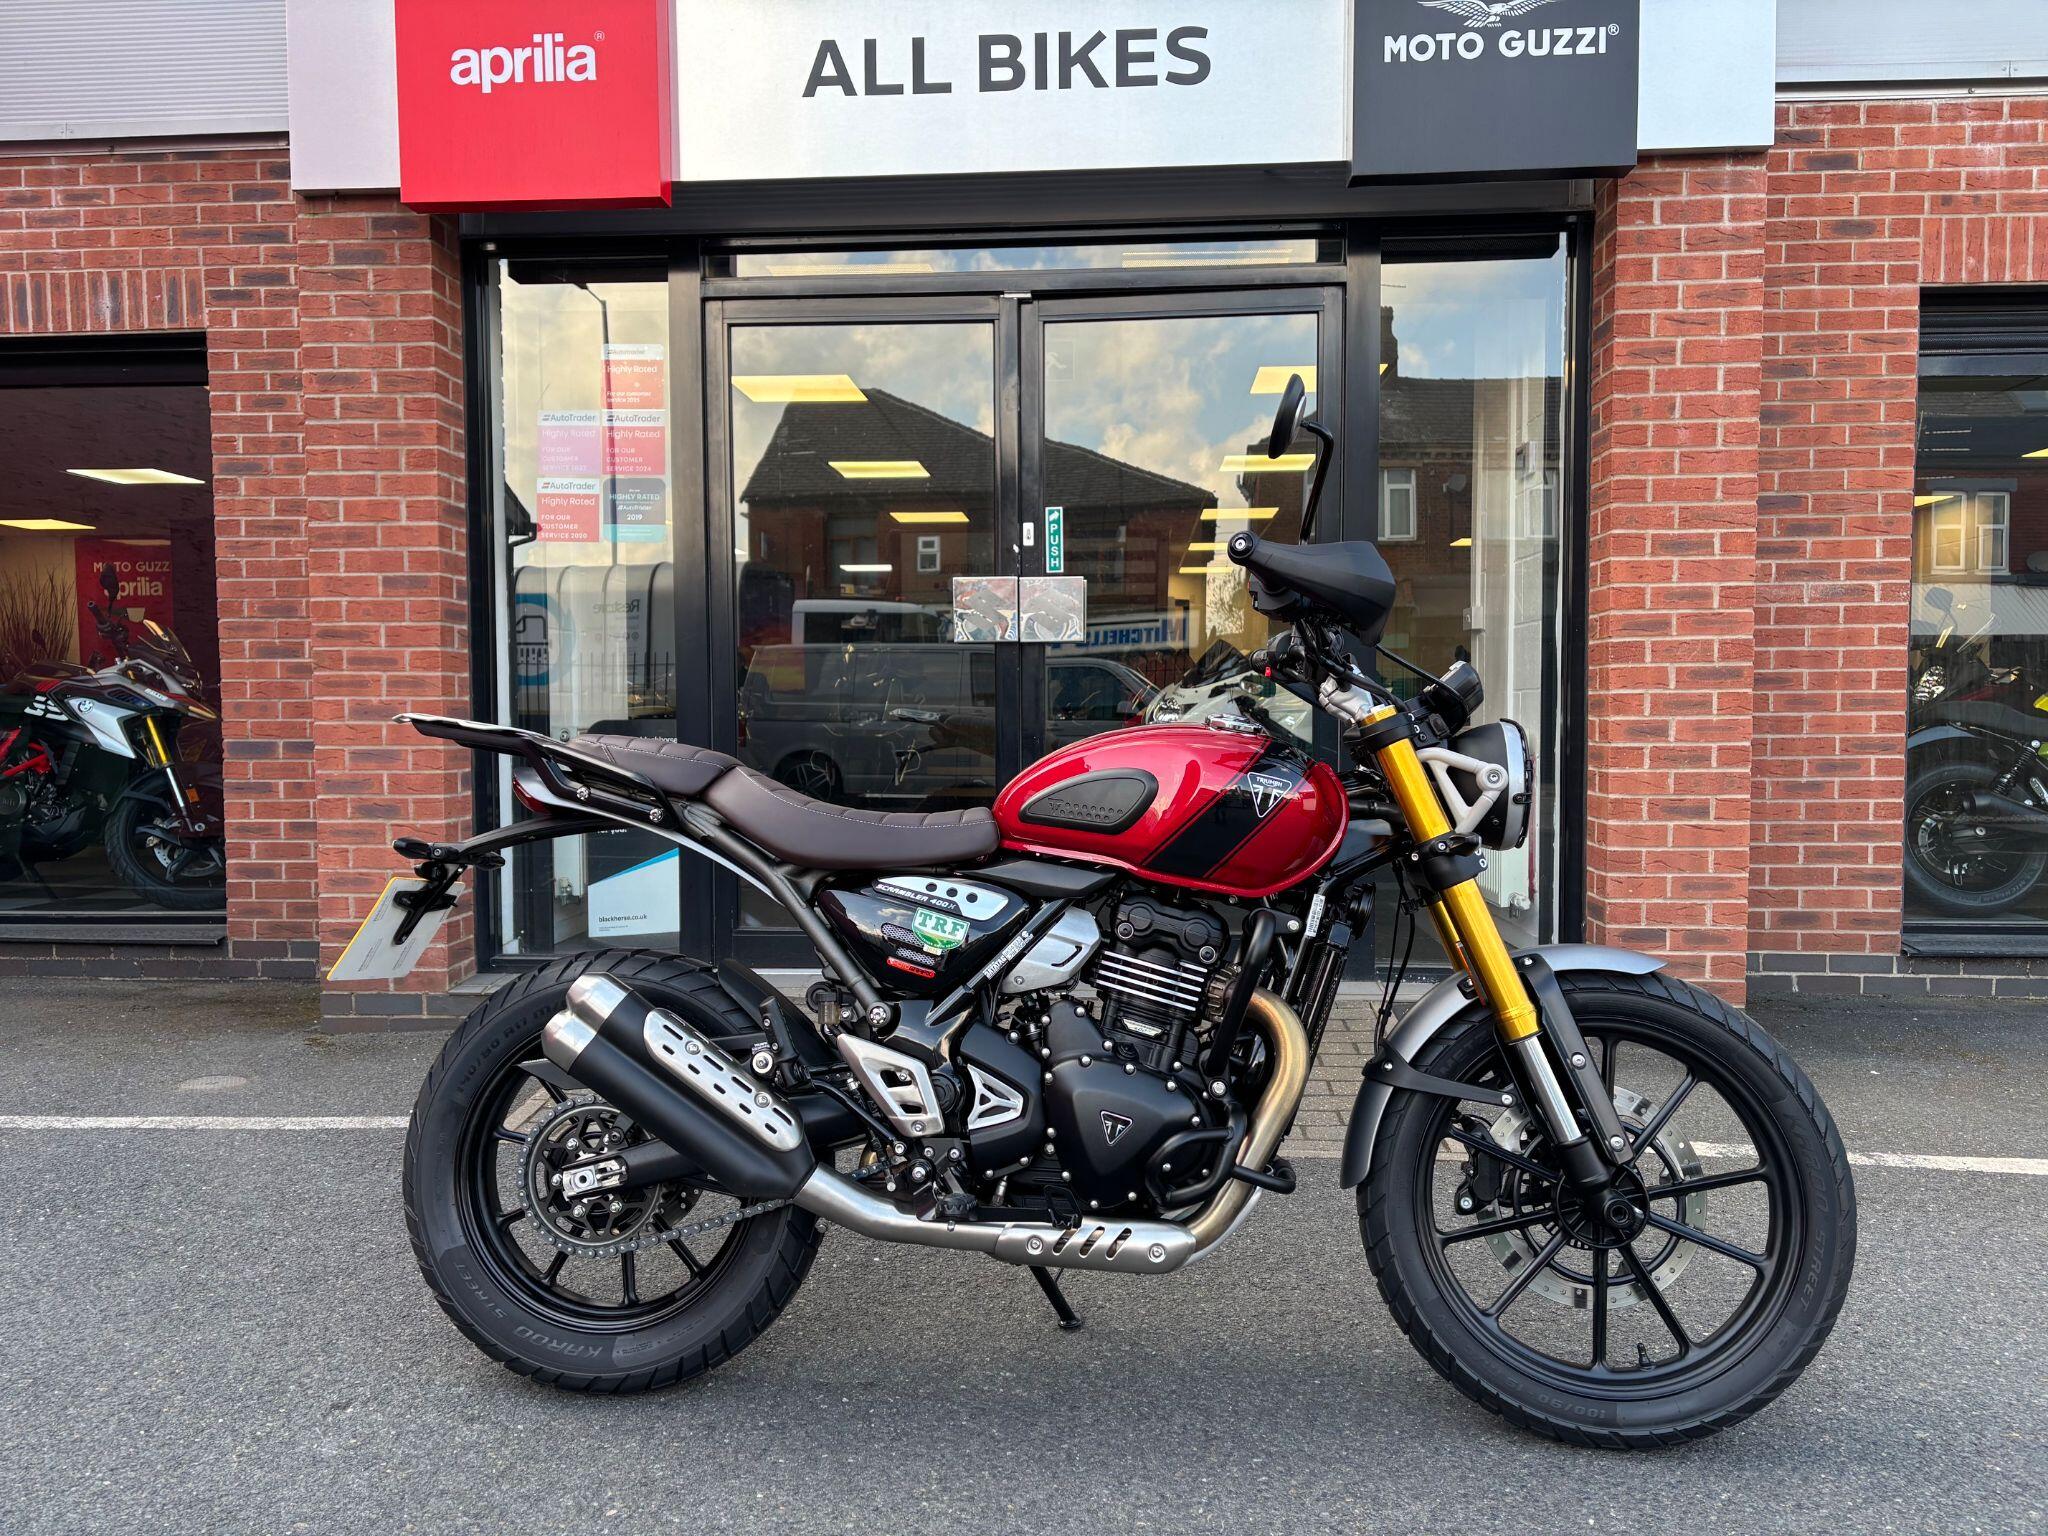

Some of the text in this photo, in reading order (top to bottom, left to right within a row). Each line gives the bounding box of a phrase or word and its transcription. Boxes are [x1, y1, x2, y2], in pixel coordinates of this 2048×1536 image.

[1384, 31, 1485, 63] MOTO
[802, 25, 1212, 98] ALL BIKES
[551, 413, 596, 422] AutoTrader
[614, 414, 661, 423] AutoTrader
[607, 430, 660, 440] Highly Rated
[550, 481, 595, 490] AutoTrader
[541, 497, 595, 507] Highly Rated
[609, 493, 660, 501] HIGHLY RATED
[626, 513, 643, 521] 2019
[1050, 523, 1060, 568] PUSH
[93, 561, 132, 573] MTO
[104, 576, 163, 600] prilia
[1256, 776, 1283, 788] TRIUMPH
[875, 883, 929, 902] SCRAMBLER
[598, 913, 648, 923] blackhorse.co.uk
[918, 911, 966, 938] TRF
[1800, 1229, 1826, 1313] STREET
[454, 1262, 604, 1359] KAROO STREET
